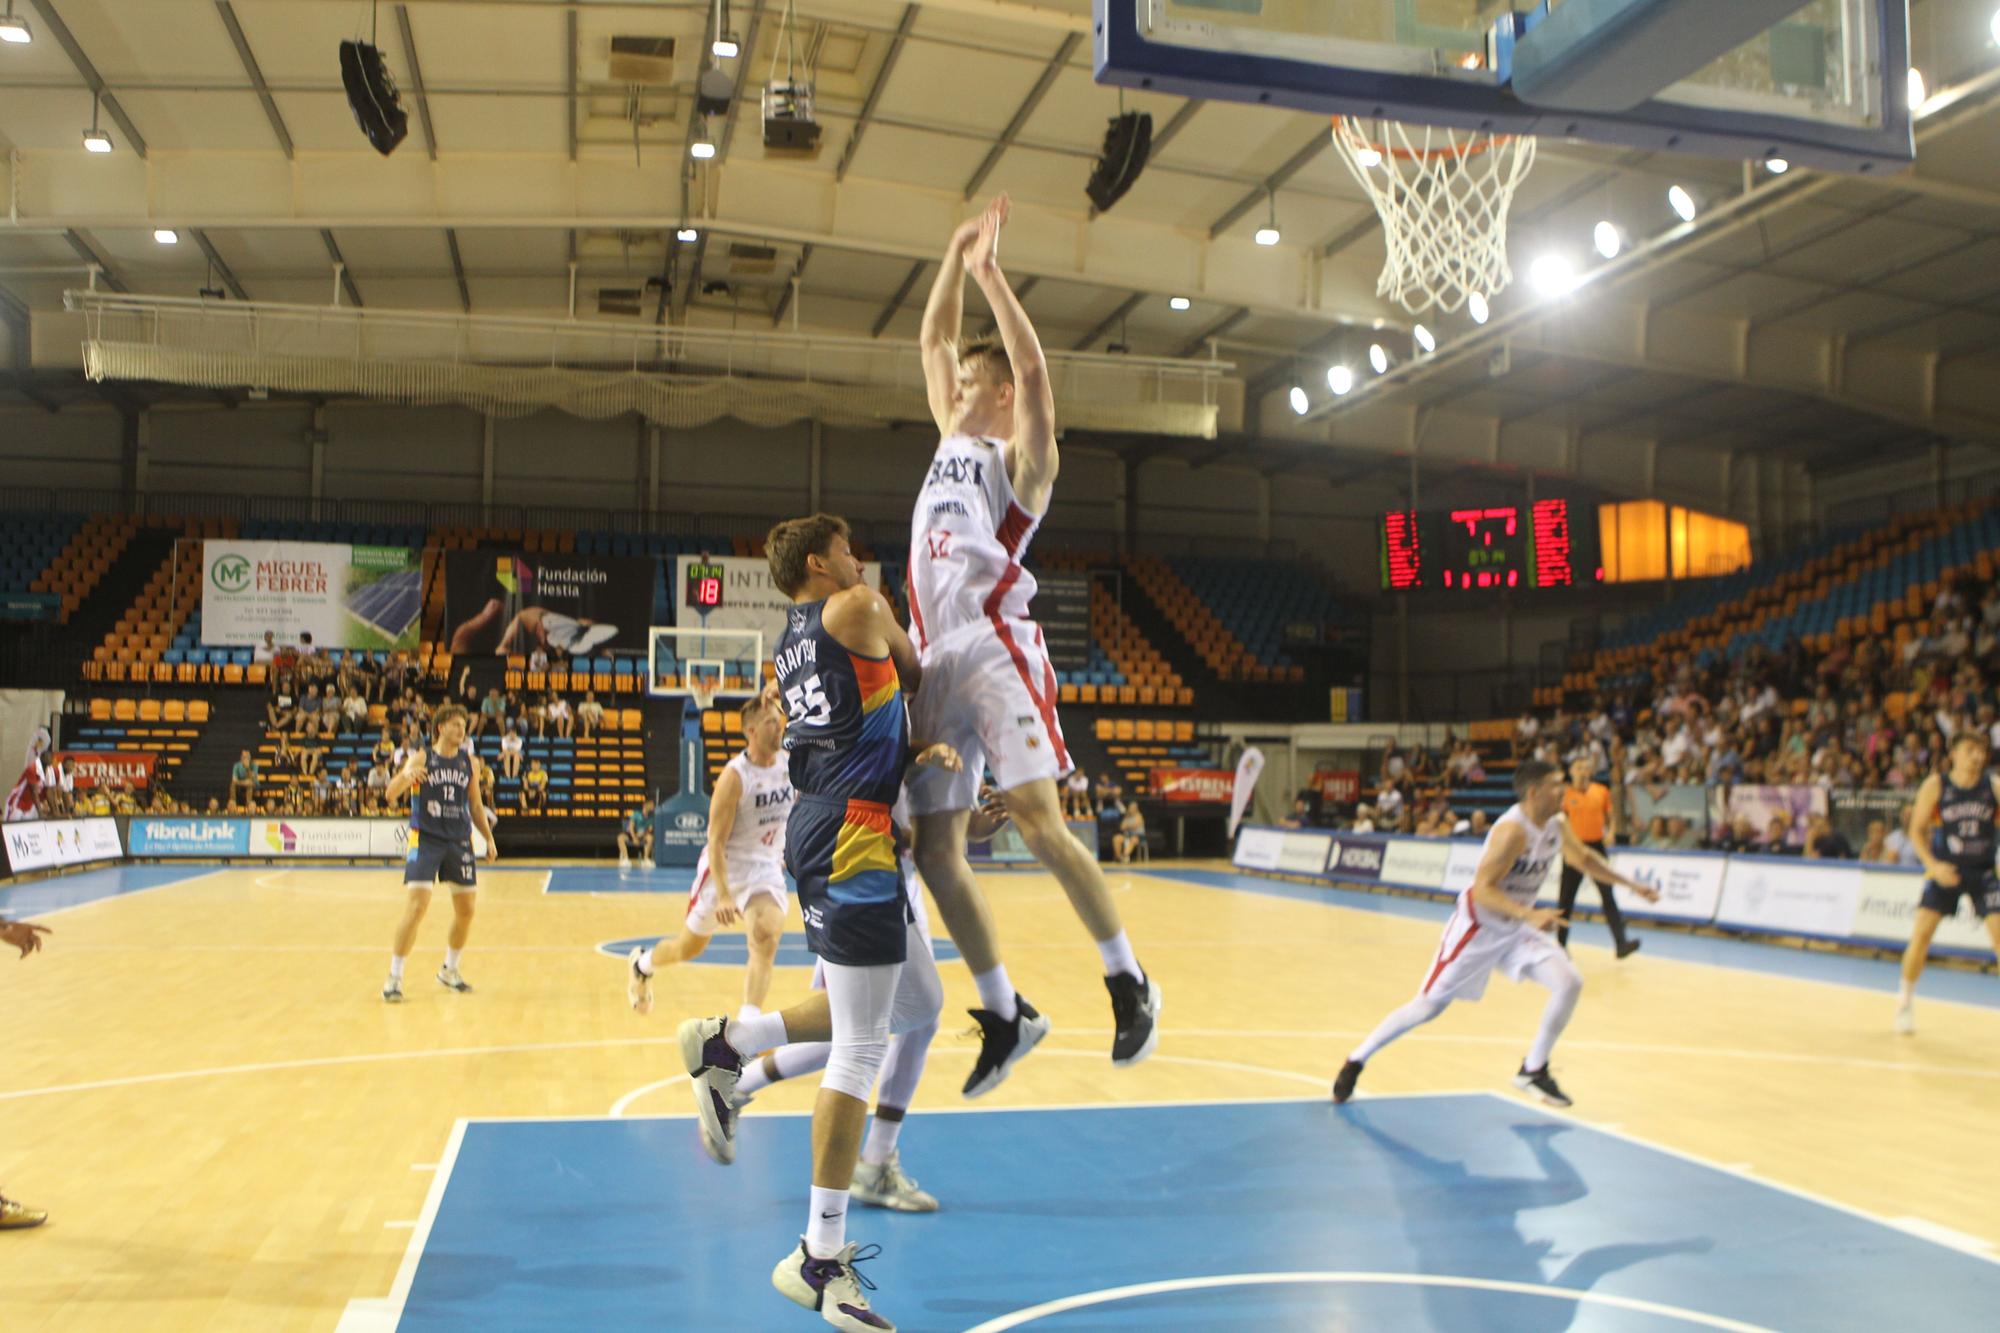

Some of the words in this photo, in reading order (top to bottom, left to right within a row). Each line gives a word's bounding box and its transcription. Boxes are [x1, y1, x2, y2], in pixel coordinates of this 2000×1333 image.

[256, 560, 328, 577] MIGUEL
[537, 566, 607, 583] Fundación
[256, 577, 328, 594] FEBRER
[537, 582, 580, 597] Hestia
[700, 578, 720, 605] 18
[785, 674, 831, 728] 55
[443, 785, 455, 800] 12
